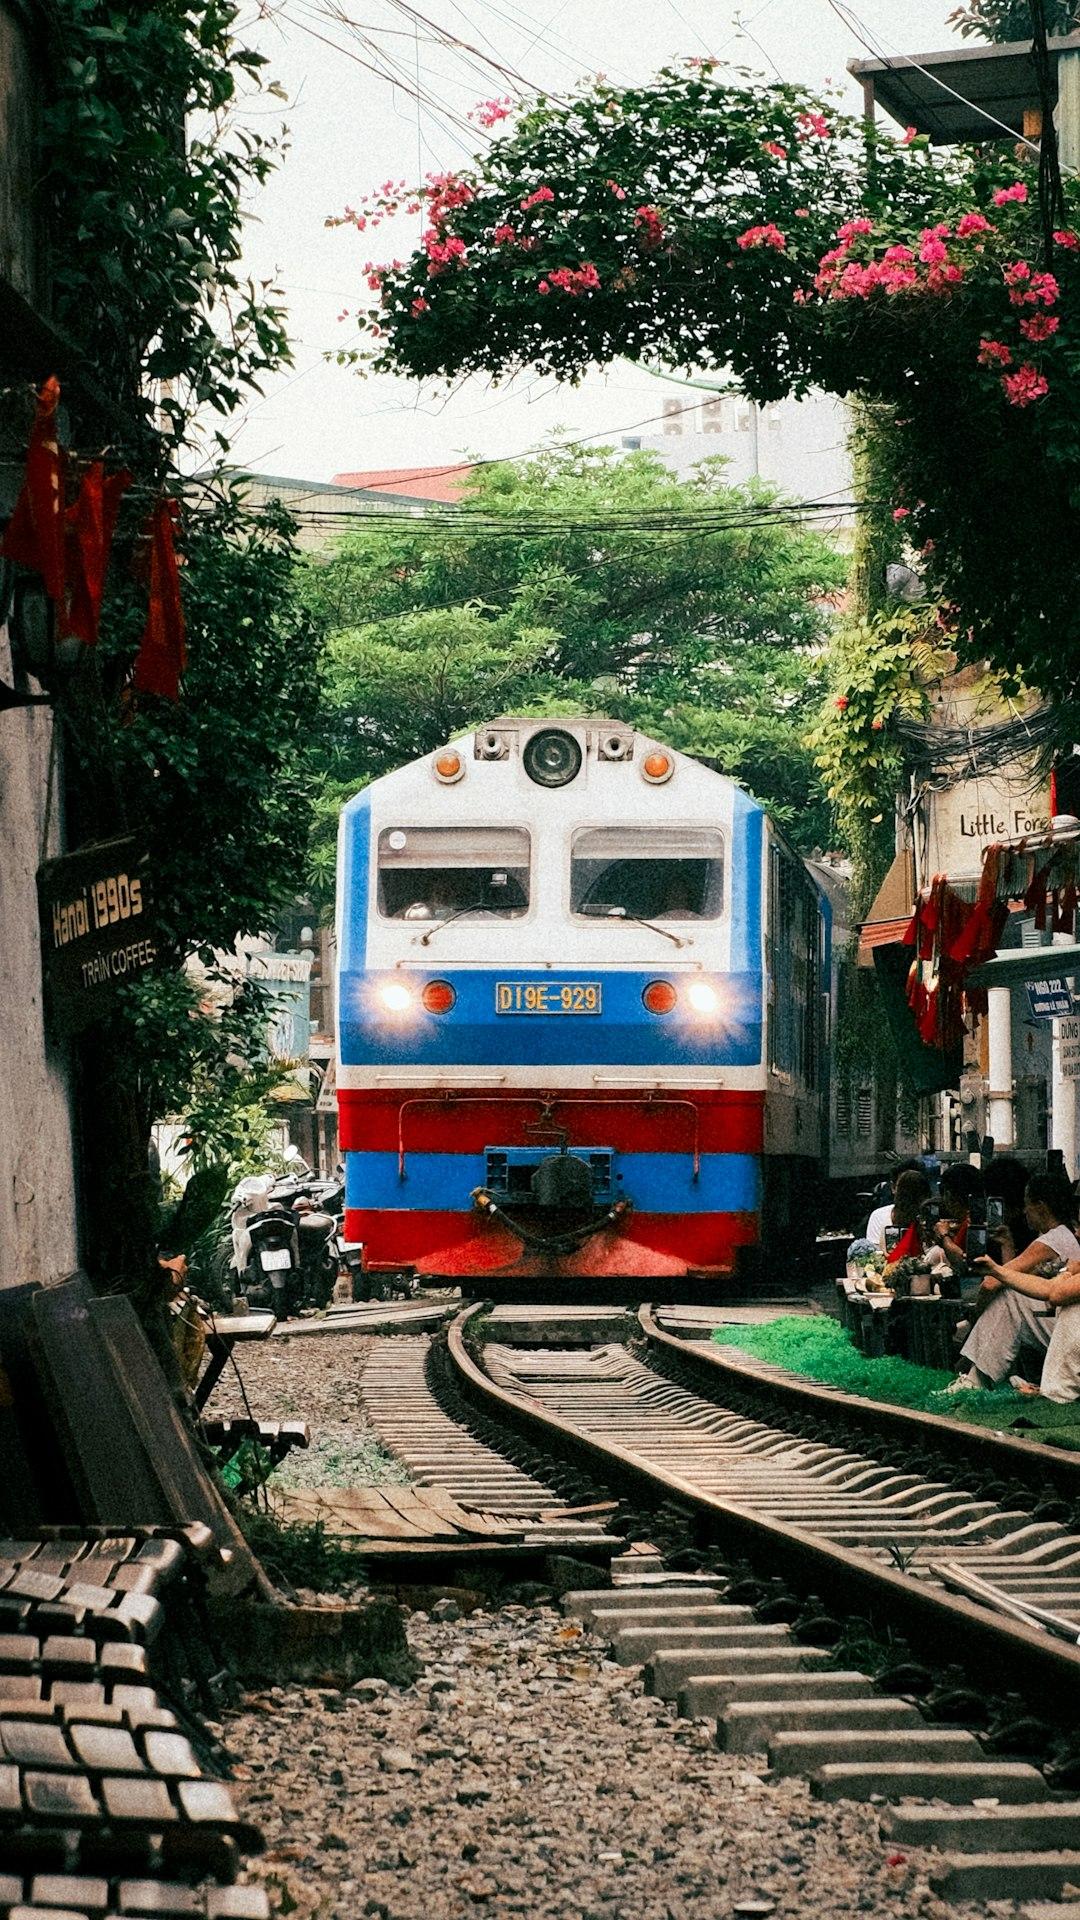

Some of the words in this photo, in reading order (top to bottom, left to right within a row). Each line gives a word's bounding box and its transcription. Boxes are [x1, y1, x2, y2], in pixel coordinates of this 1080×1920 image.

[961, 814, 1005, 837] Little
[52, 887, 90, 949] Hanoi
[92, 874, 143, 929] 1990s
[111, 940, 155, 976] COFFEE
[500, 986, 597, 1010] D19E-929
